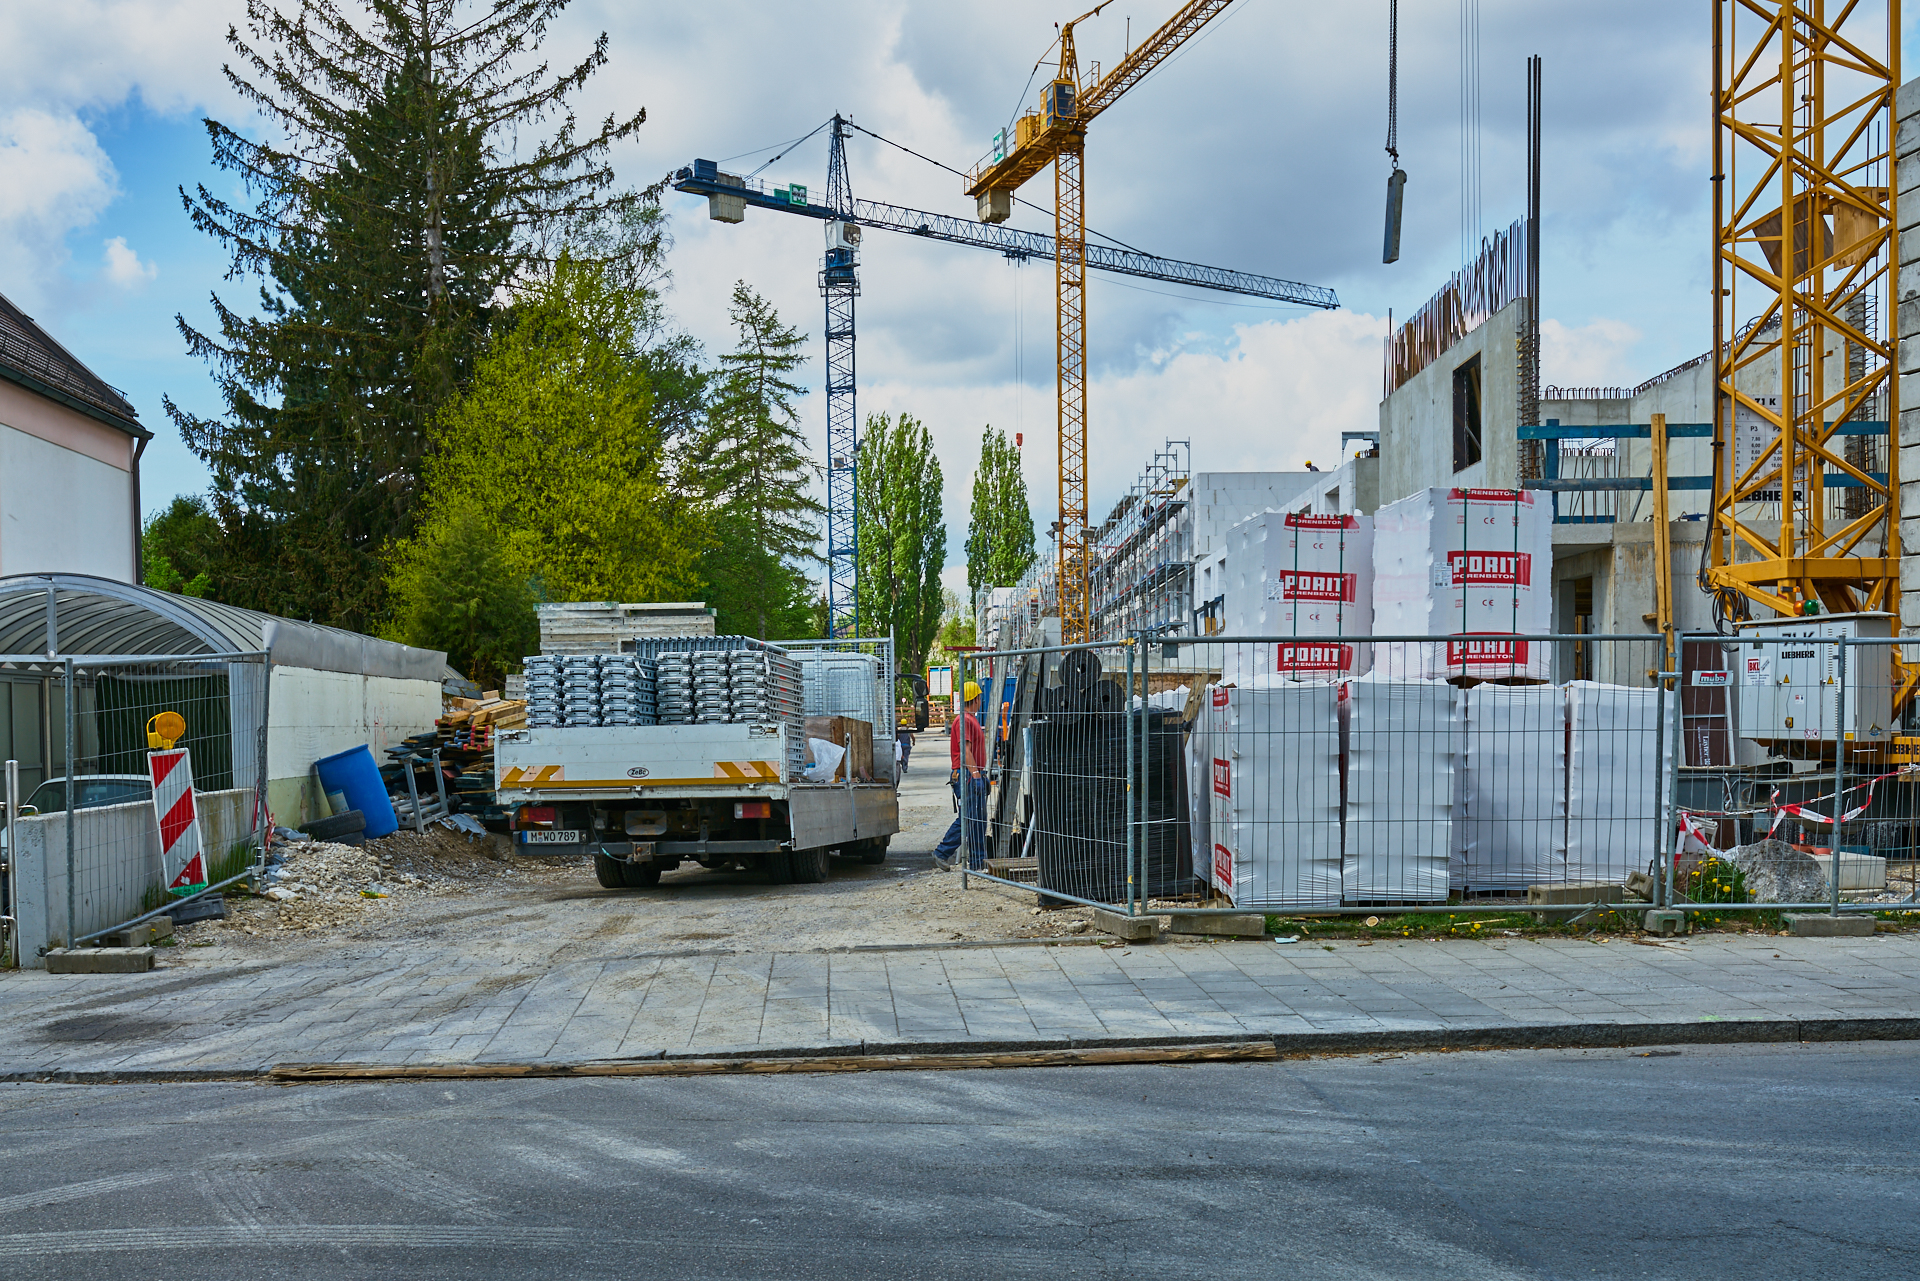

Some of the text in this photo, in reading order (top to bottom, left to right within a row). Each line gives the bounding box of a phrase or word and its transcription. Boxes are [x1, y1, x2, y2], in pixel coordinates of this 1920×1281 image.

[1453, 556, 1519, 573] PORIT
[1285, 575, 1344, 592] PORIT
[1284, 648, 1339, 662] PORIT
[1782, 651, 1815, 659] LIEBHERR
[1750, 662, 1760, 671] BKL
[531, 831, 576, 841] M WO 789
